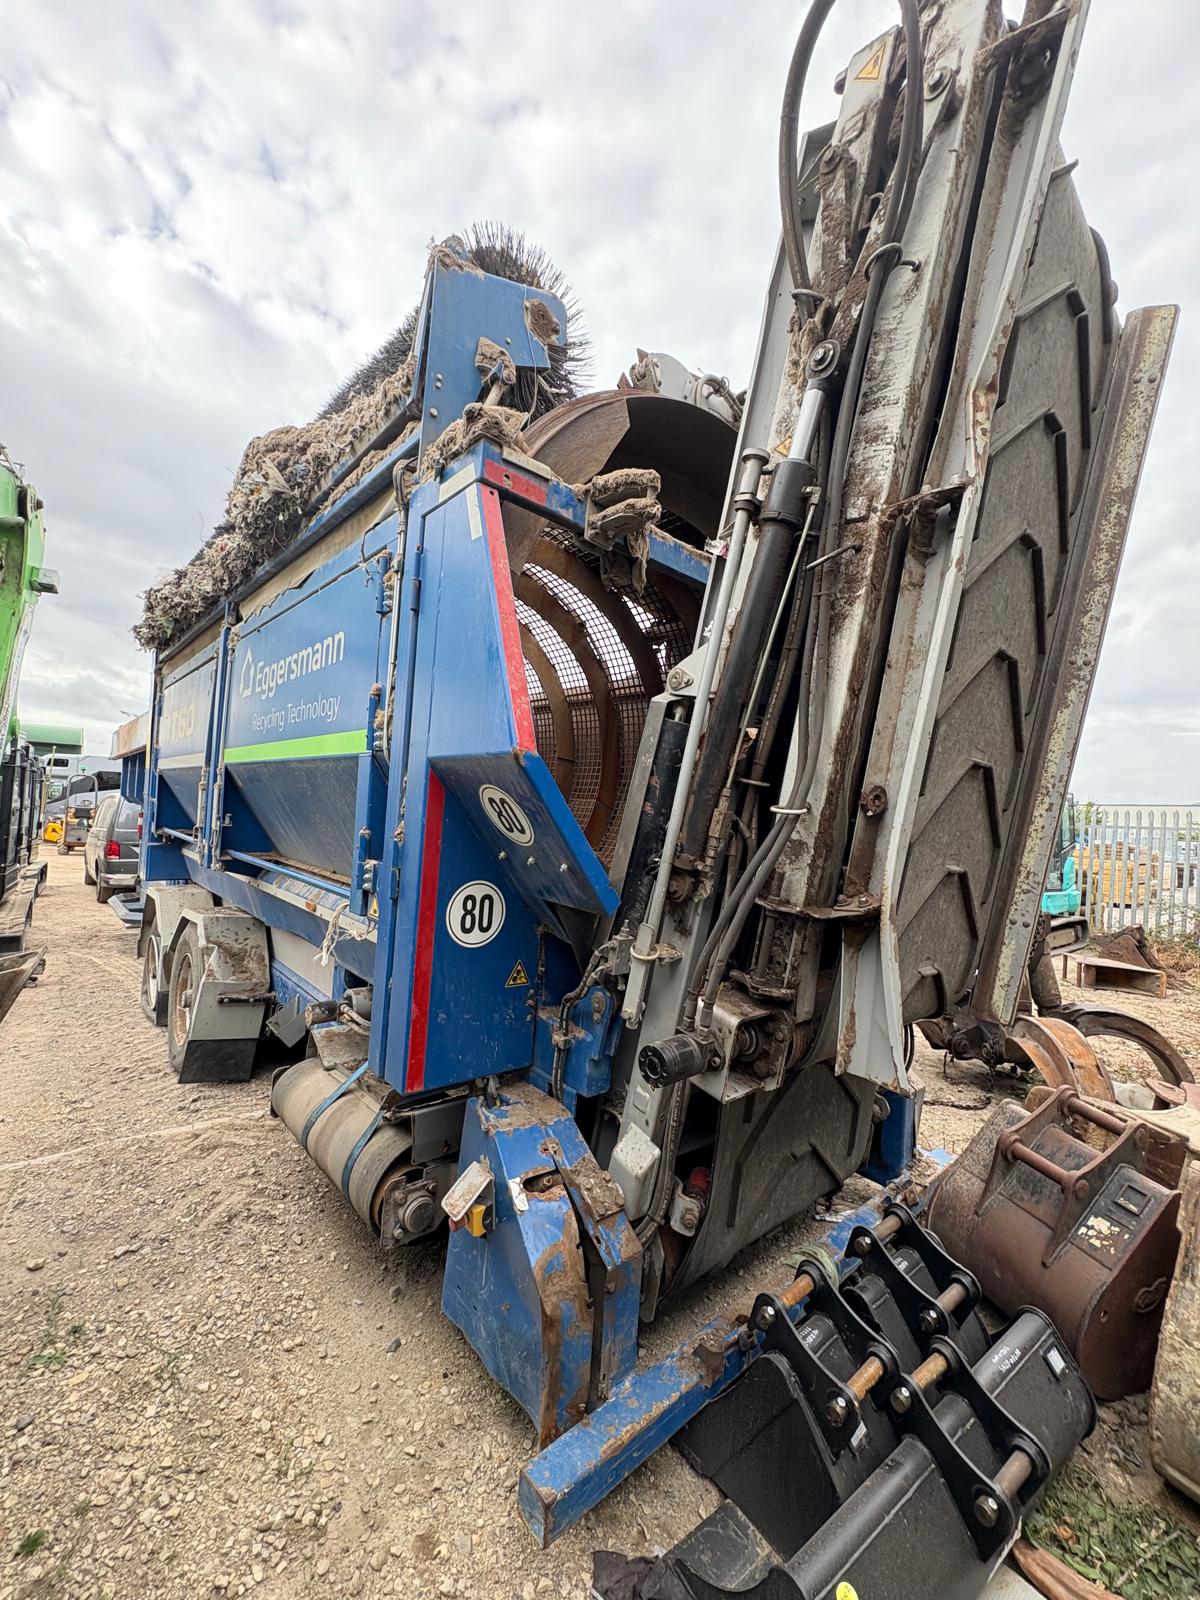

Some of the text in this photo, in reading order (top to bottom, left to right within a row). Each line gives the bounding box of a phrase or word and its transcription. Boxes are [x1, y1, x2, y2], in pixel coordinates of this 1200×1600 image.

[255, 630, 345, 700] Eggersmann
[252, 694, 341, 732] Recycling Technology
[487, 796, 527, 835] 80
[460, 893, 494, 935] 80
